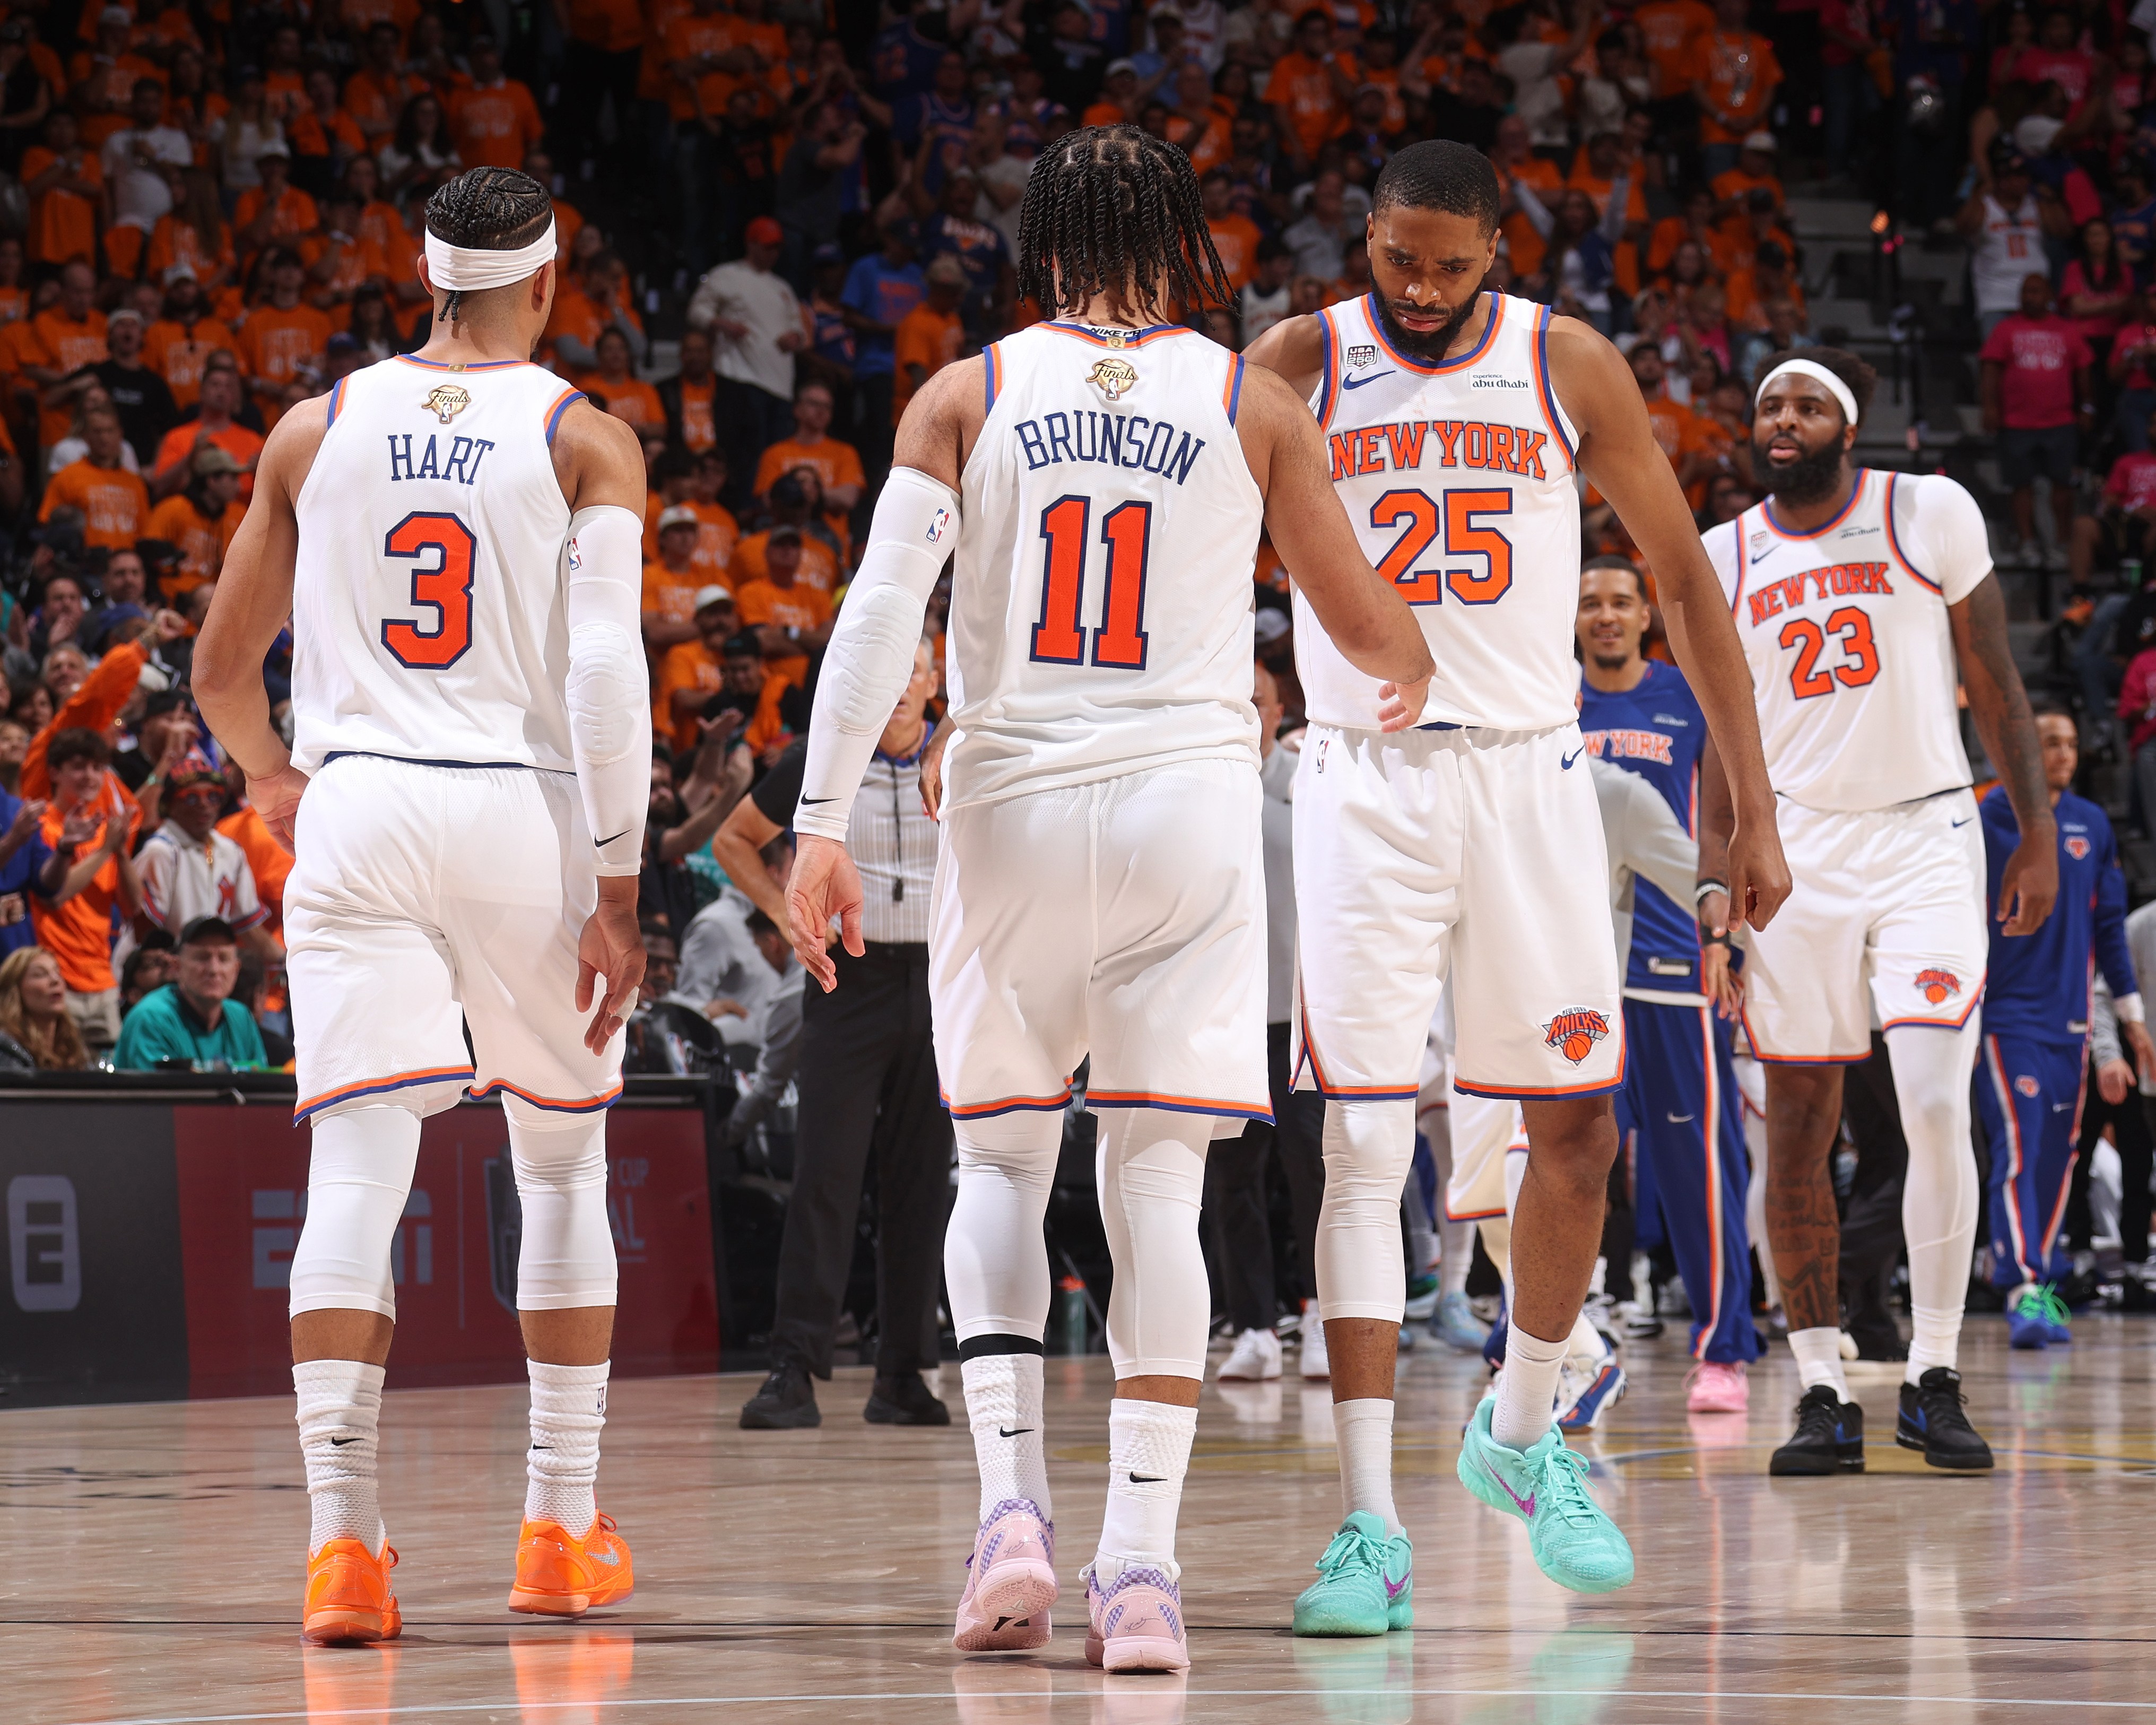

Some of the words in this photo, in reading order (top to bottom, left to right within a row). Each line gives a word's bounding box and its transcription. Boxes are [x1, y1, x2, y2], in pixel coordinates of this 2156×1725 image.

[1091, 327, 1122, 336] NIKE
[1089, 363, 1137, 380] Finals
[1347, 356, 1373, 364] 250
[423, 390, 469, 407] Finals
[1472, 379, 1494, 388] abu
[1496, 379, 1529, 388] dhabi
[388, 434, 495, 486] HART
[1014, 410, 1206, 486] BRUNSON
[1329, 421, 1429, 482] NEW
[1432, 420, 1548, 481] YORK
[1370, 488, 1513, 606] 25
[381, 511, 477, 670] 3
[1029, 494, 1152, 671] 11
[1748, 572, 1807, 628] NEW
[1809, 561, 1894, 600] YORK
[1778, 605, 1880, 700] 23
[1609, 728, 1673, 766] YORK
[1544, 1010, 1610, 1044] KNICKS
[618, 1157, 649, 1187] CUP
